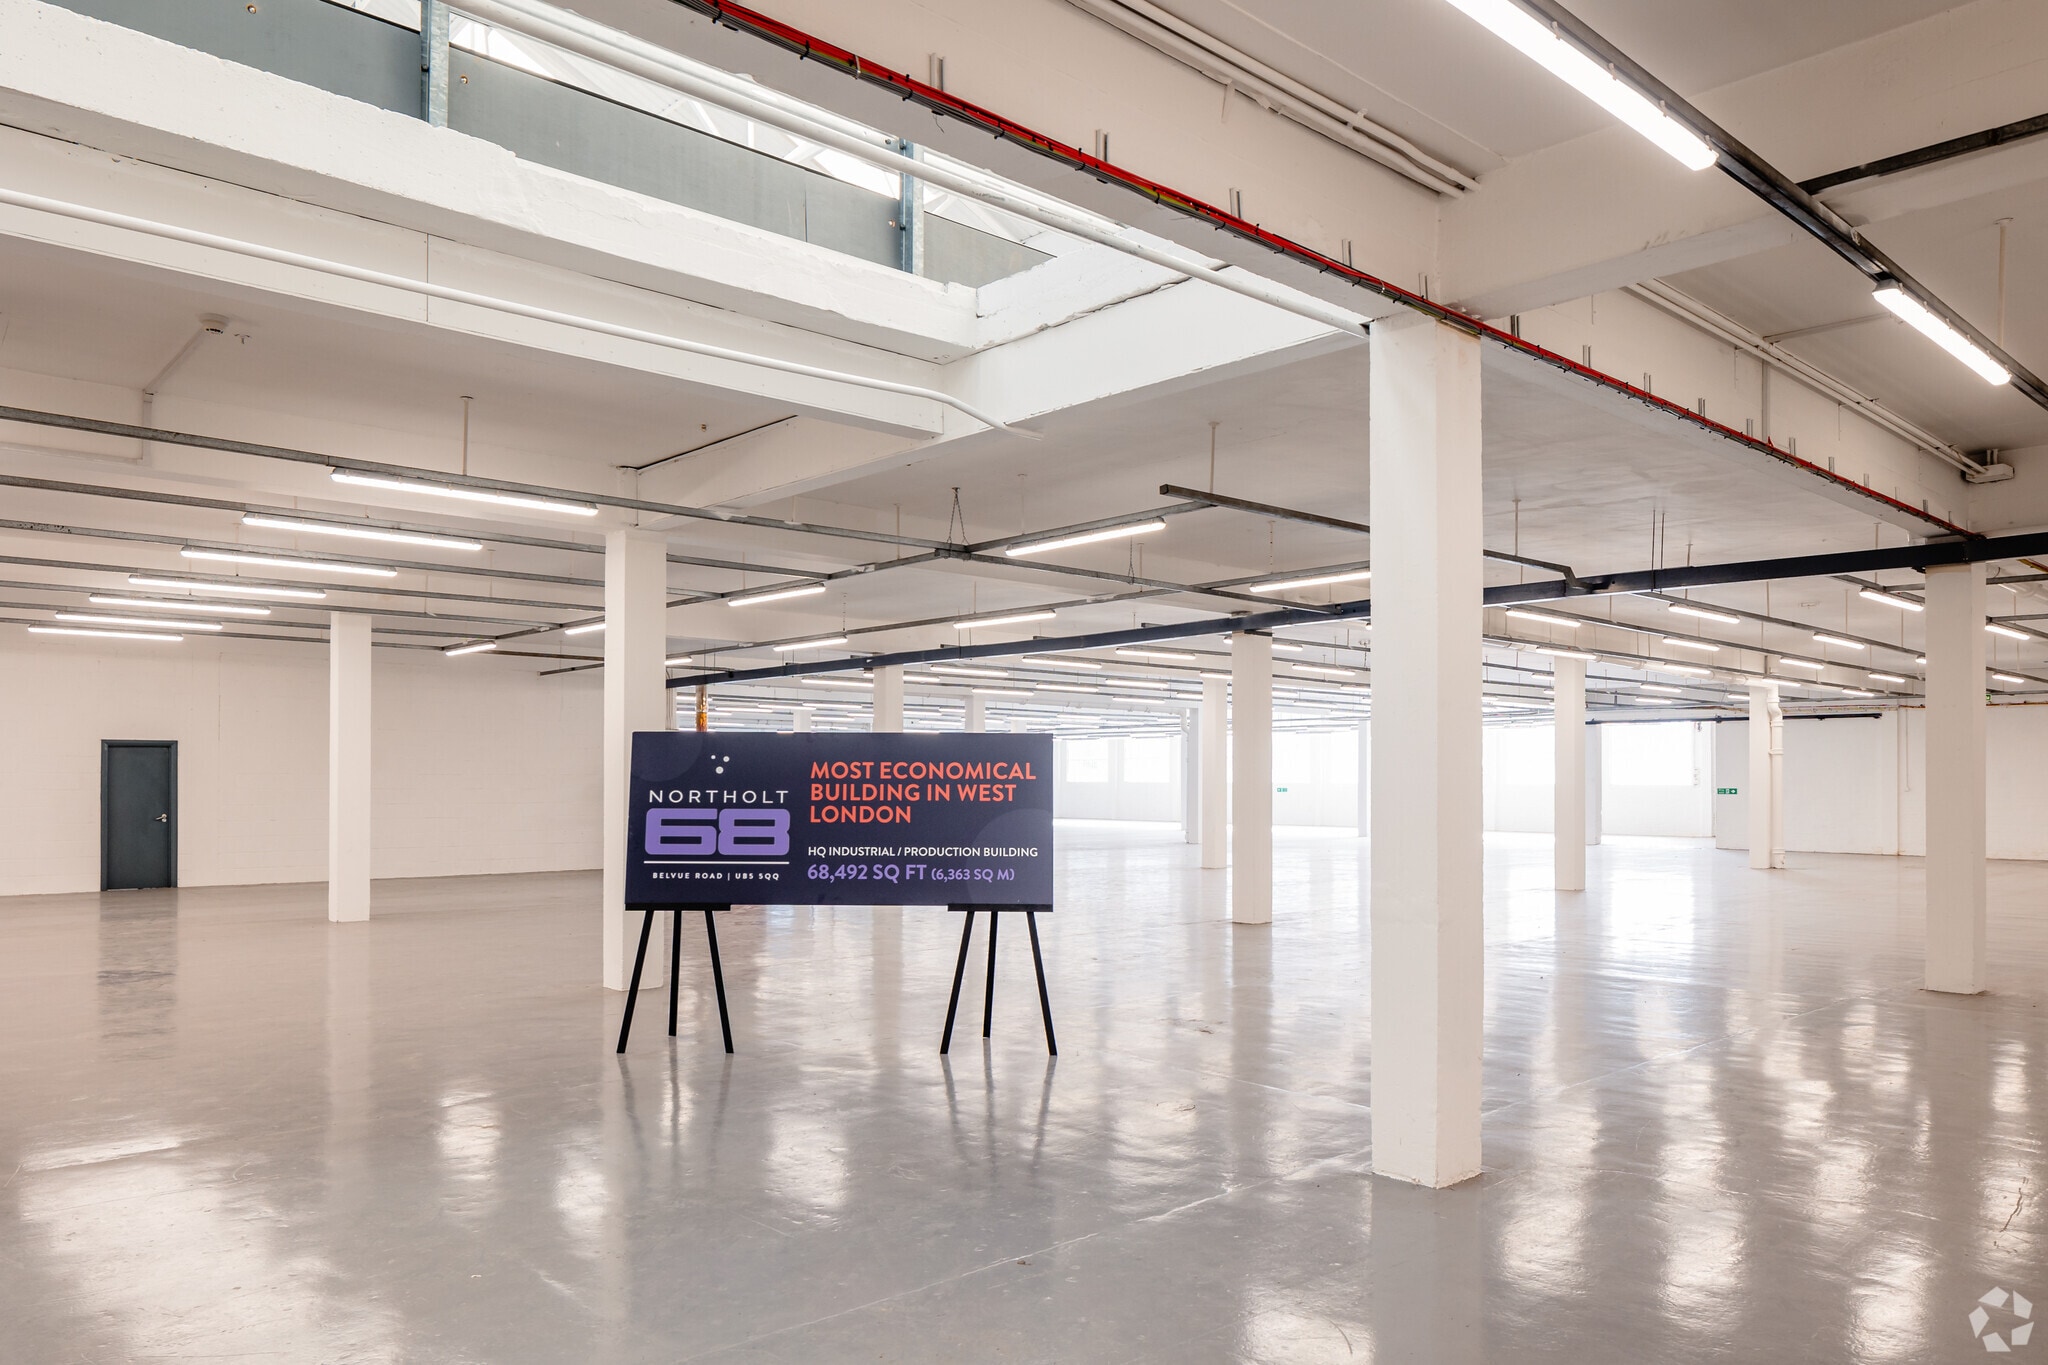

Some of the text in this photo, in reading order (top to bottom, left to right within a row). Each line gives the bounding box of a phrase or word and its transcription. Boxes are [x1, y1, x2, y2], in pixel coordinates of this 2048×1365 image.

[811, 762, 1036, 779] MOST ECONOMICAL
[650, 790, 788, 803] NORTHOLT
[811, 784, 1016, 801] BUILDING IN WEST
[811, 806, 910, 823] LONDON
[645, 808, 790, 855] 68
[807, 846, 827, 859] HQ
[828, 846, 896, 857] INDUSTRIAL
[904, 846, 981, 857] PRODUCTION
[983, 847, 1039, 858] BUILDING
[652, 872, 690, 880] BELVUE
[694, 872, 723, 880] ROAD
[808, 864, 1014, 883] 68,492 SQ FT (6,363 SQ M)
